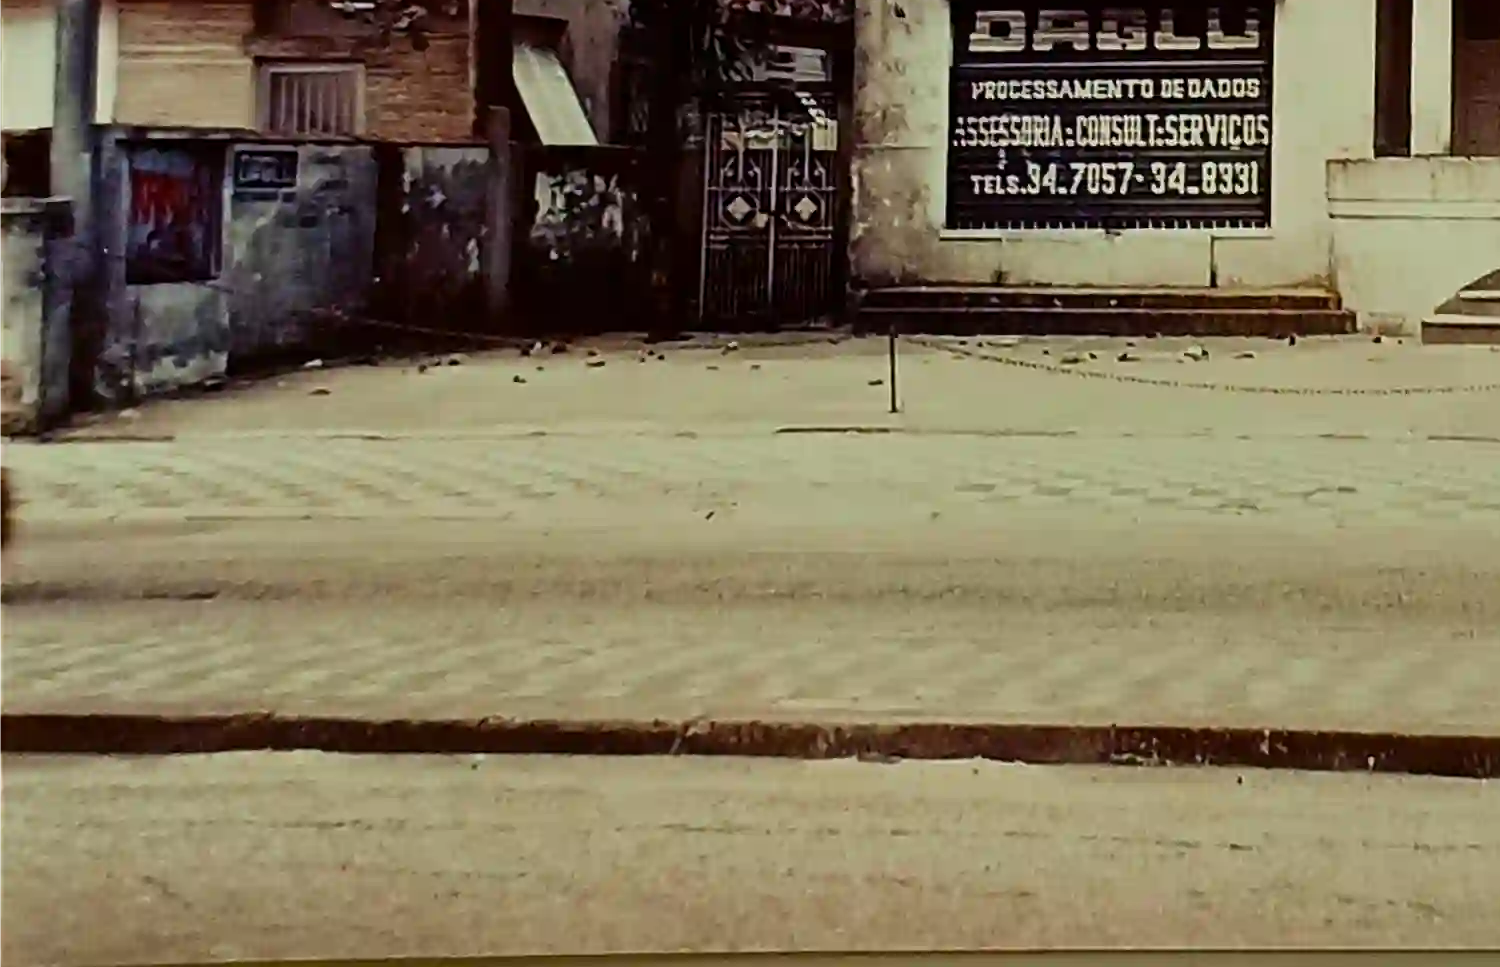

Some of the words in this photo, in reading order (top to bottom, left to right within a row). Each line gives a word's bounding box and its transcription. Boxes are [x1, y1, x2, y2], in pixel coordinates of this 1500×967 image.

[971, 78, 1154, 100] PROCESSAMENTO
[1160, 78, 1185, 99] DE
[1187, 78, 1261, 99] DADOS
